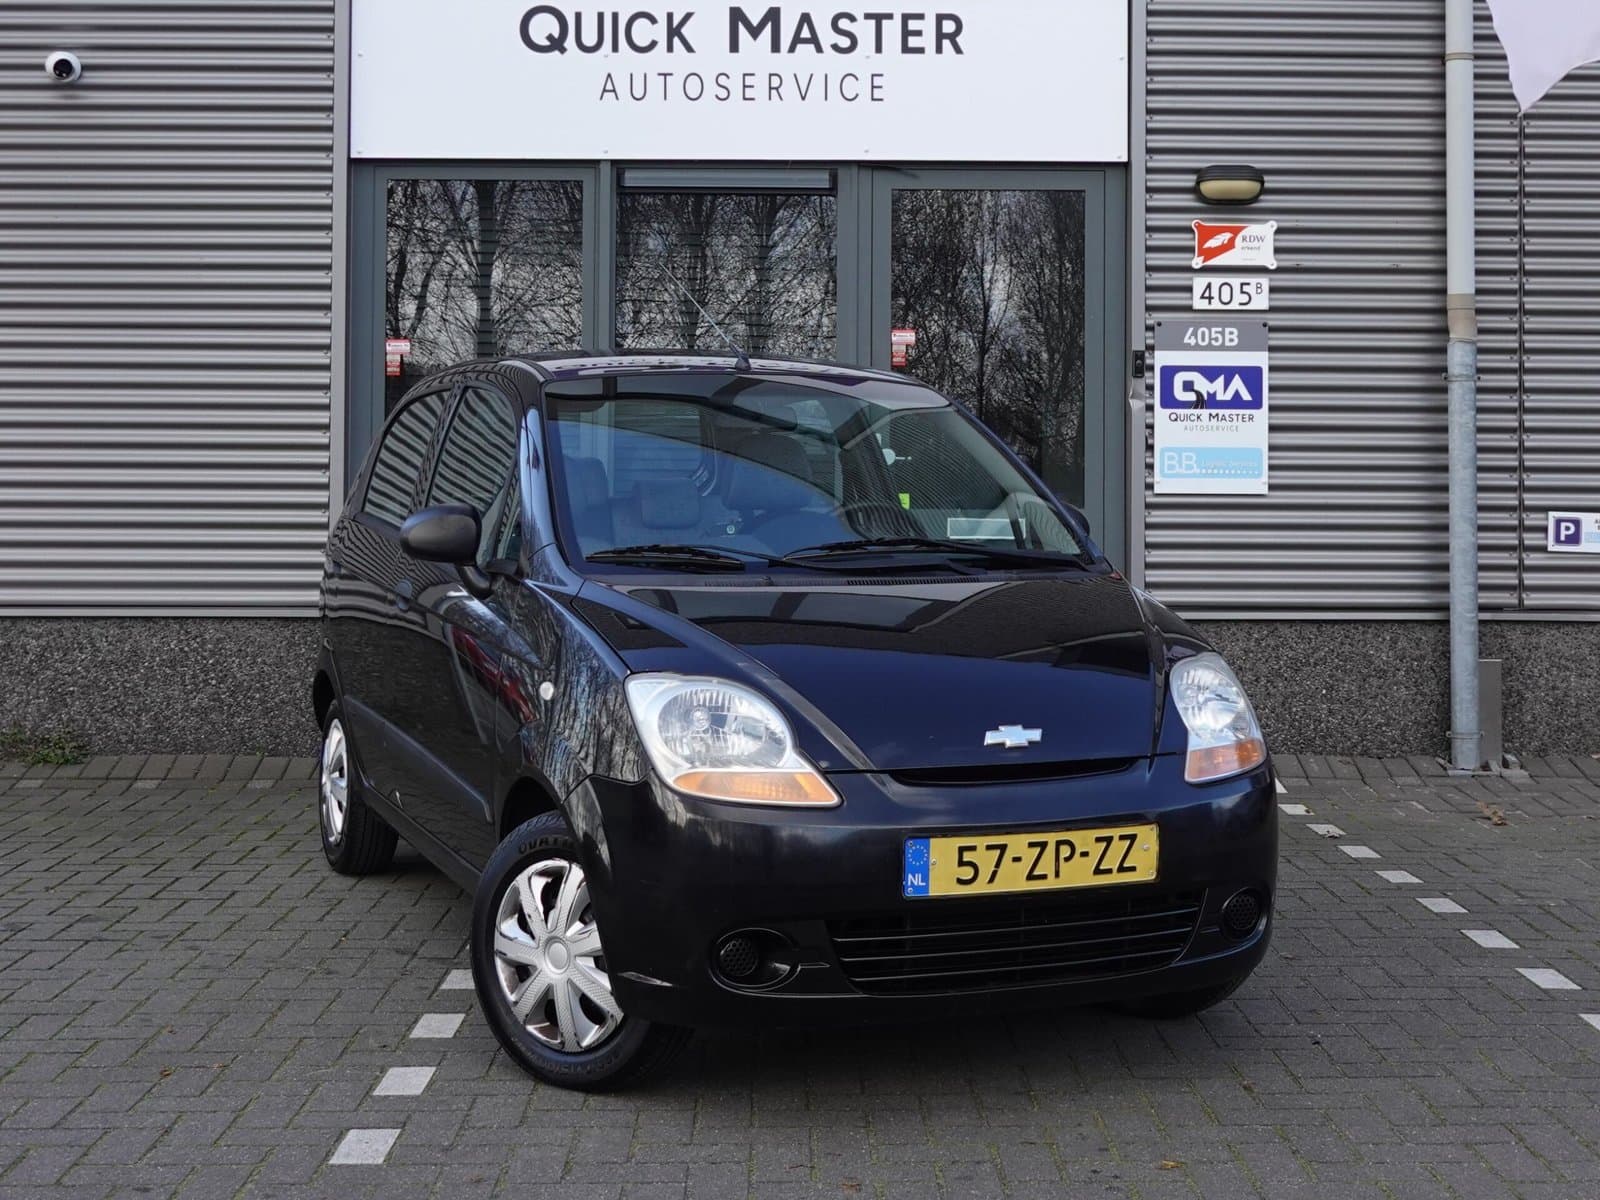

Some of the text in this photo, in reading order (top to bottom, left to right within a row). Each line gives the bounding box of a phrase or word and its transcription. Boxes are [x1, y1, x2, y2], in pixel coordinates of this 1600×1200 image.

[519, 5, 965, 55] QUICK MASTER
[600, 73, 885, 101] AUTOSERVICE
[1241, 234, 1266, 244] RDW
[1183, 327, 1239, 347] 405B
[1173, 371, 1253, 401] QMA
[1560, 521, 1576, 541] P
[955, 833, 1138, 885] 57-ZP-ZZ
[907, 873, 926, 886] NL
